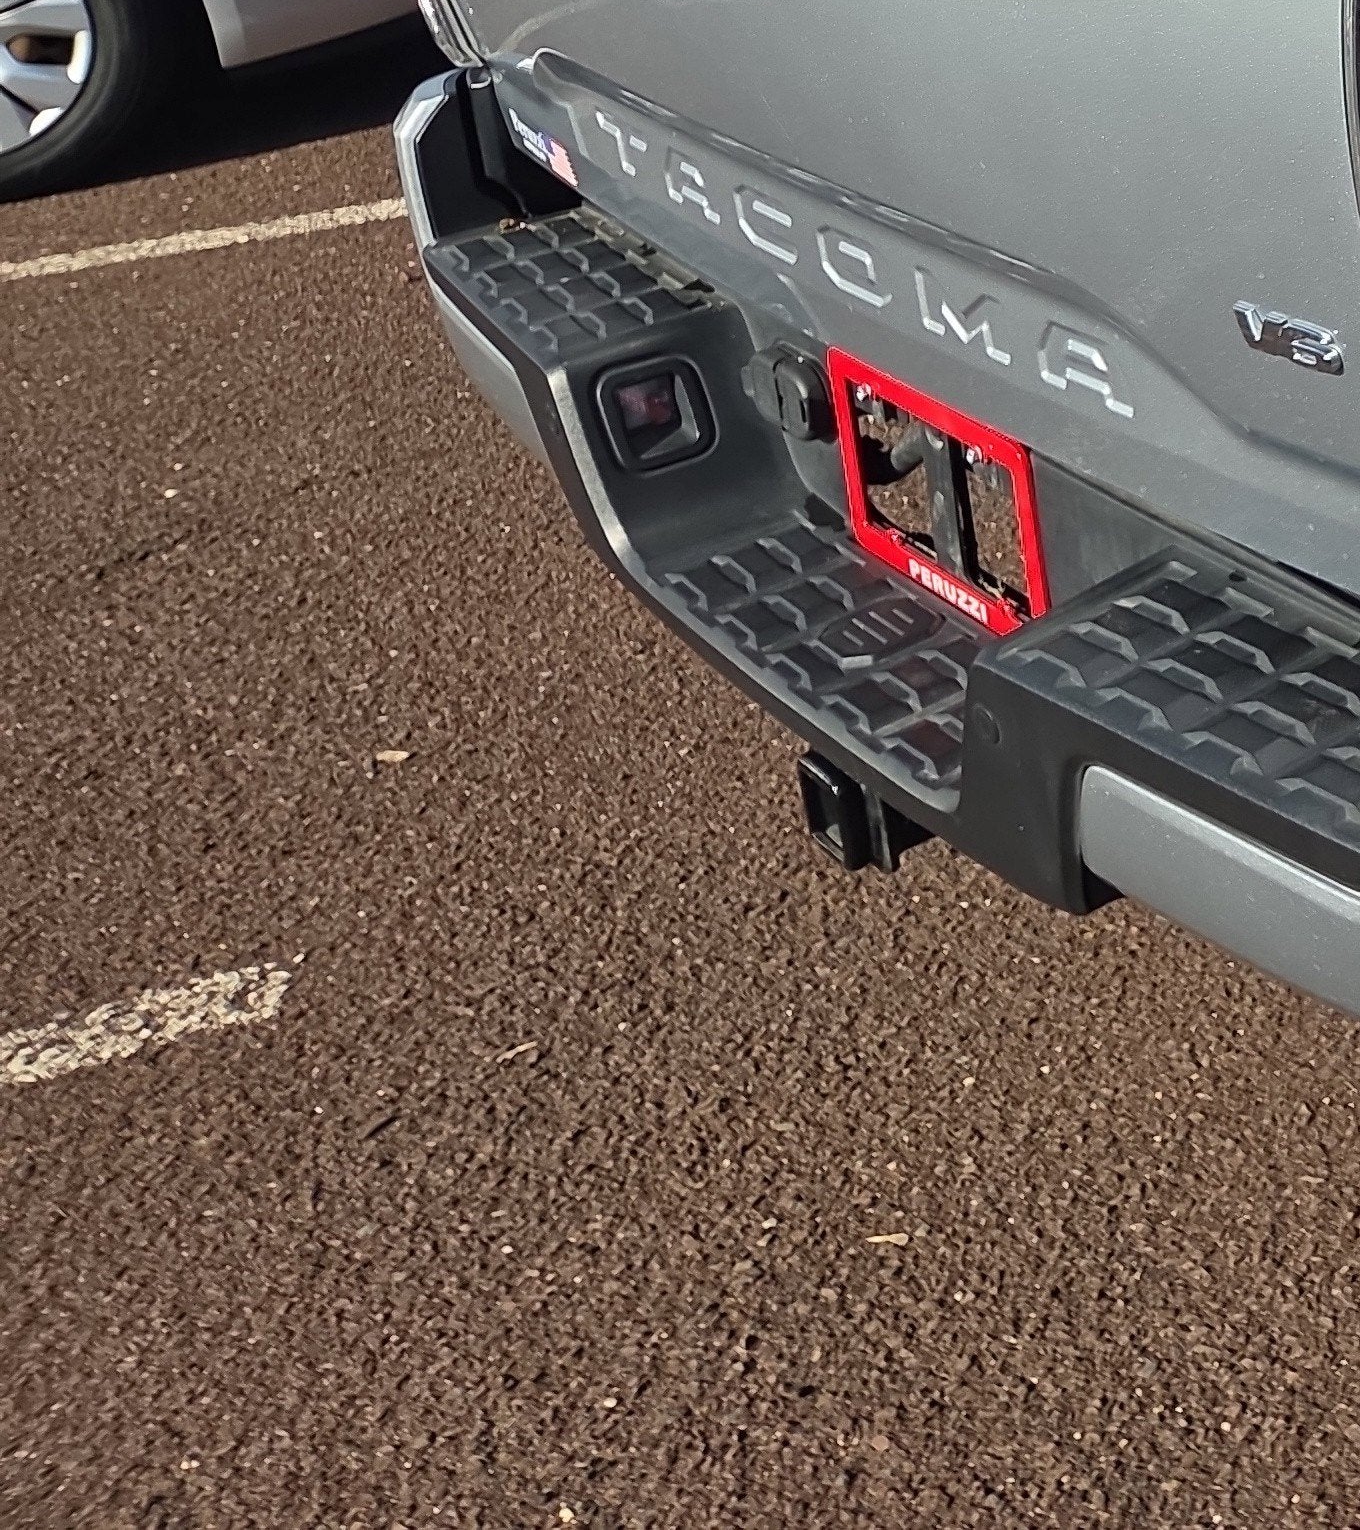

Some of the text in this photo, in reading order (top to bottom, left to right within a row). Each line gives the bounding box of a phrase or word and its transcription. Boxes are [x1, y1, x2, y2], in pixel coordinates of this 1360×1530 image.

[595, 110, 1135, 418] TACOMA
[1233, 300, 1344, 376] V6
[907, 557, 989, 624] PERUZZI
